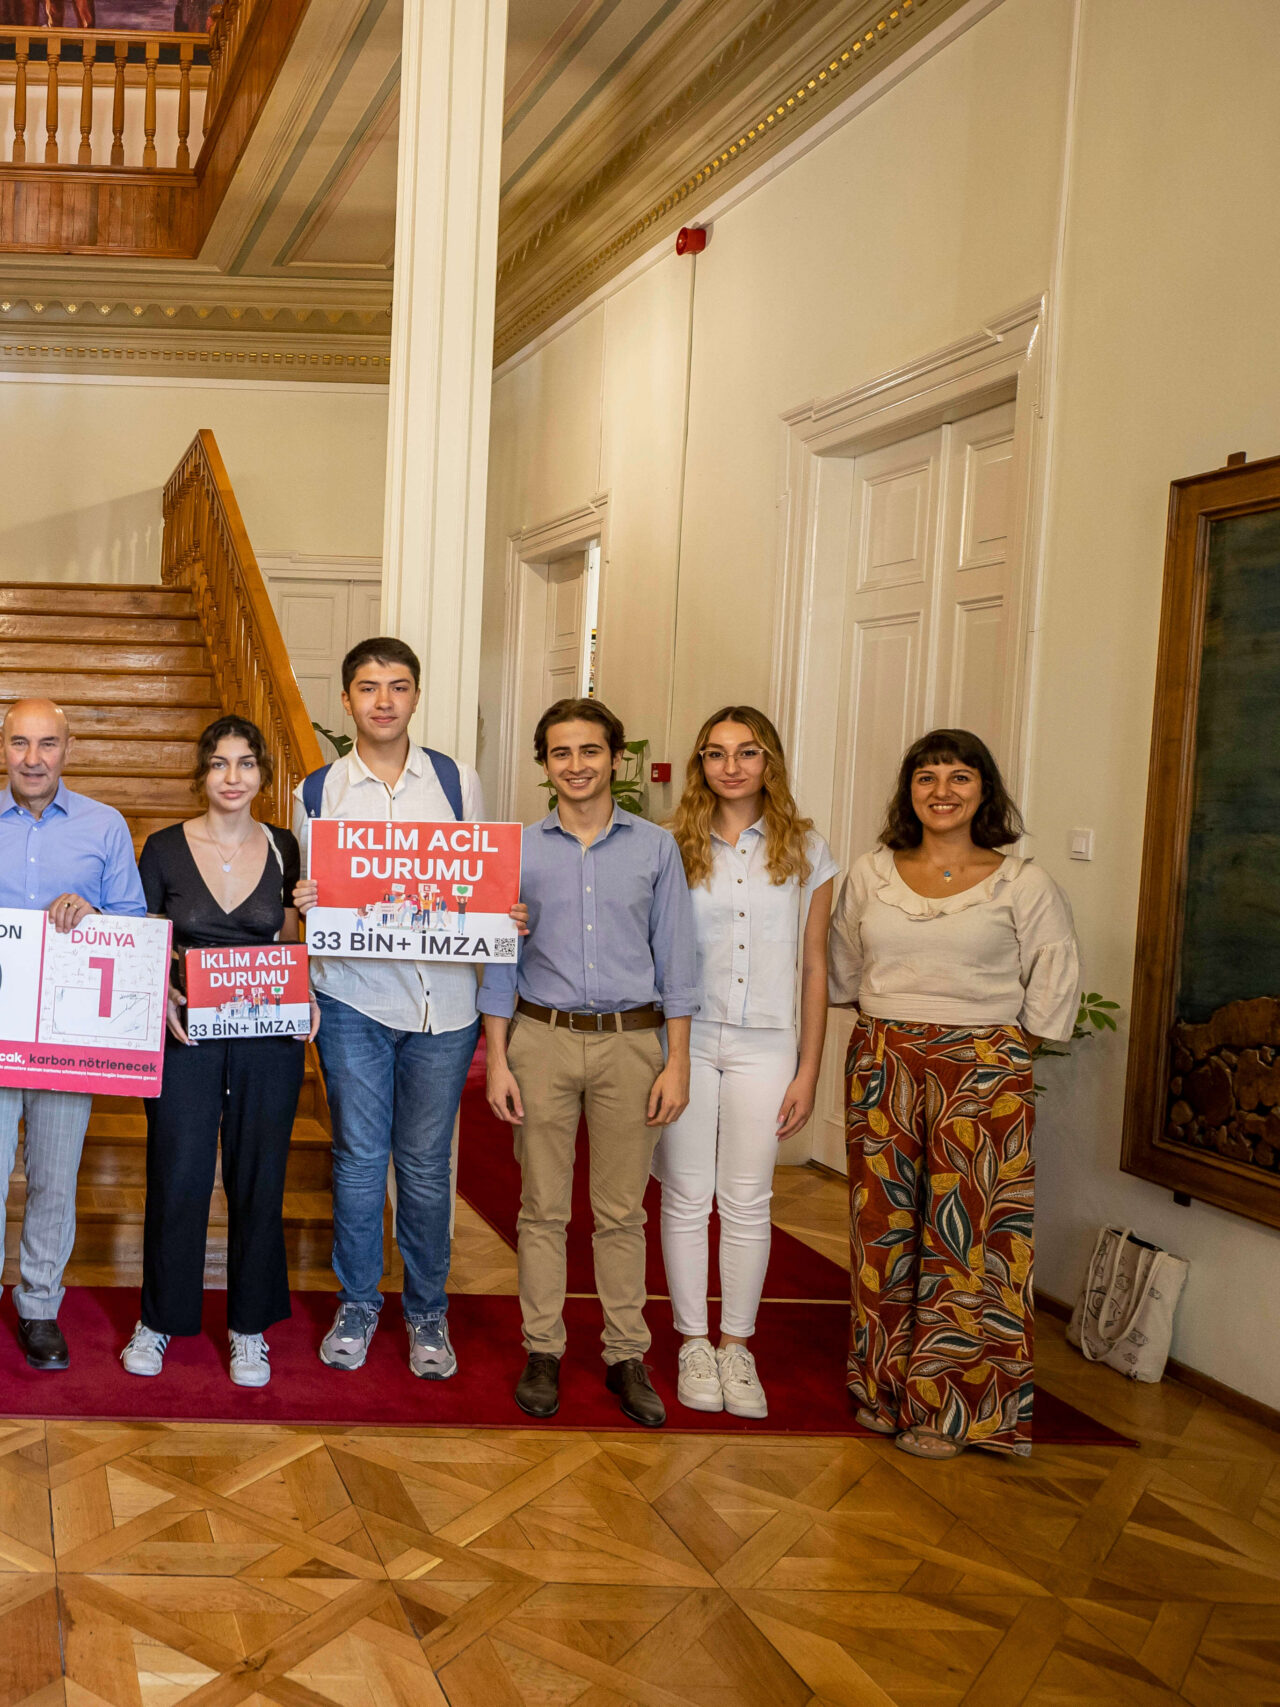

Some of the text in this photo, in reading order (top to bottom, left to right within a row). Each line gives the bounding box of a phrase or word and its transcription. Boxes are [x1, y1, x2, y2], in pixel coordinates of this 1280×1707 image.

[337, 822, 499, 853] İKLİM ACİL
[350, 856, 484, 882] DURUMU
[71, 927, 135, 948] DÜNYA
[312, 930, 342, 951] 33
[421, 930, 491, 957] İMZA
[201, 947, 297, 969] İKLİM ACİL
[88, 956, 115, 1018] 1
[210, 970, 289, 988] DURUMU
[189, 1024, 207, 1037] 33
[255, 1018, 296, 1034] İMZA
[29, 1053, 75, 1067] karbon
[78, 1057, 158, 1073] nötrlenecek
